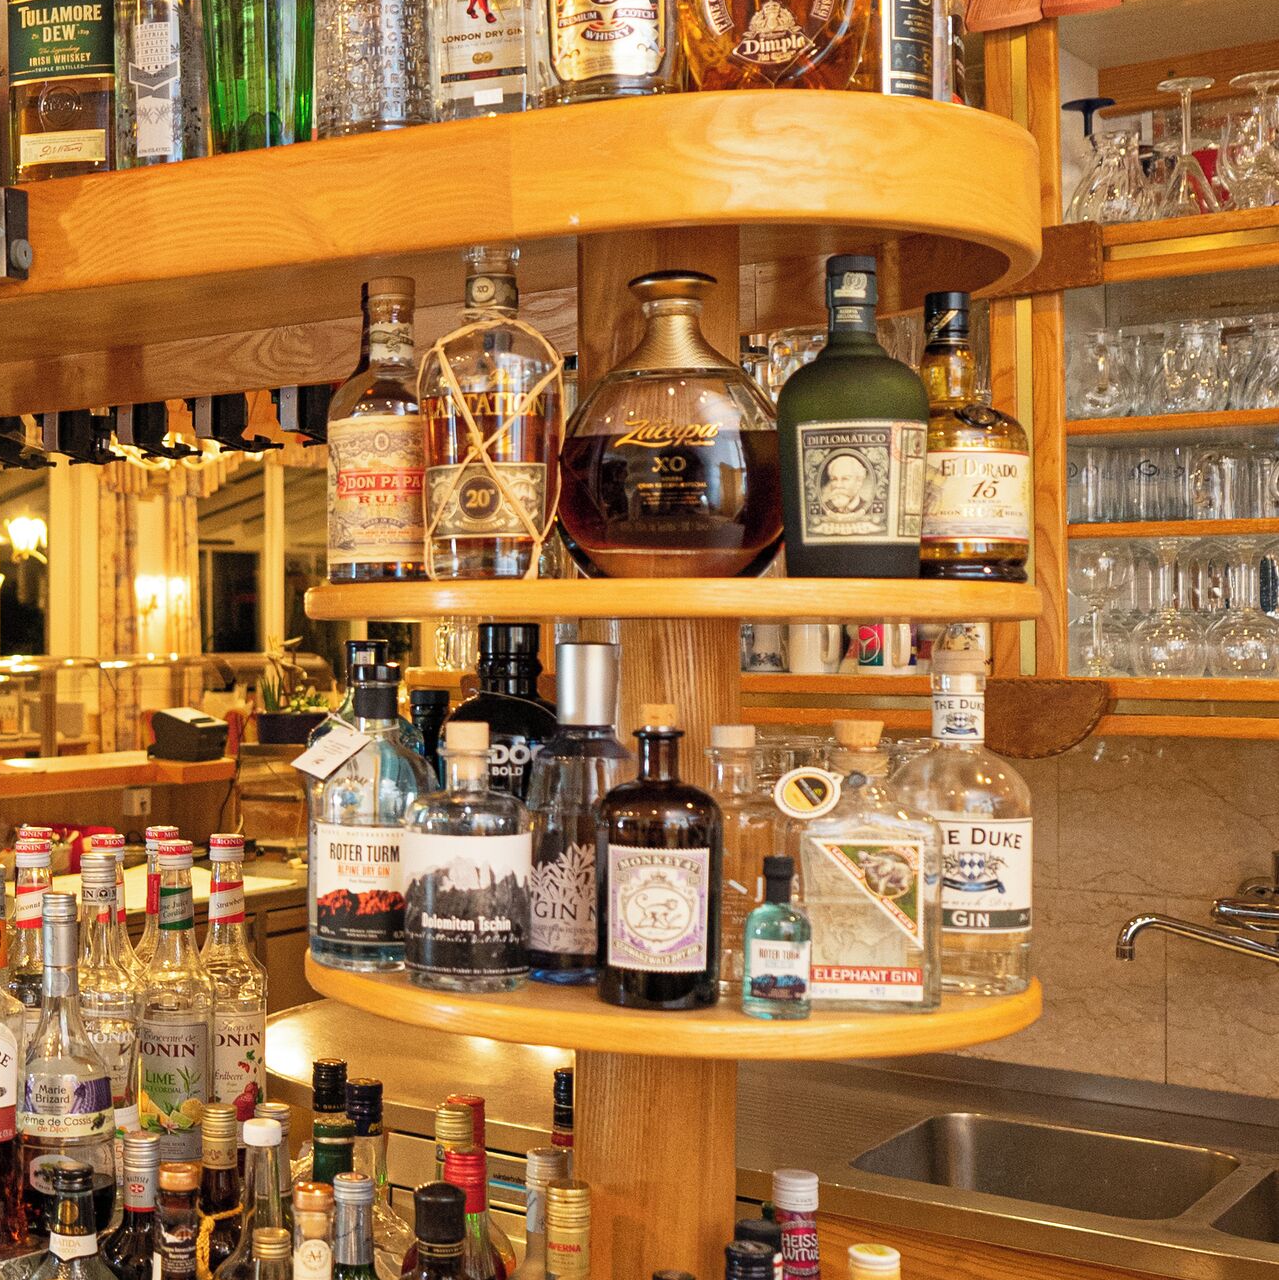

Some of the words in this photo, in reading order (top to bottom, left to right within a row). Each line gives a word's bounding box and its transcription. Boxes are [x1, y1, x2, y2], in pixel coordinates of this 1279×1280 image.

[17, 3, 103, 28] TULLAMORE
[557, 10, 598, 28] PREMIUM
[616, 8, 655, 20] SCOTCH
[42, 23, 76, 42] DEW
[441, 30, 482, 44] LONDON
[484, 28, 504, 40] DRY
[506, 26, 525, 37] GIN
[585, 26, 631, 40] WHISKY
[743, 34, 806, 56] Dimple
[29, 54, 51, 67] IRISH
[53, 52, 91, 64] WHISKEY
[614, 419, 720, 448] Zacapa
[651, 456, 687, 473] XO
[940, 459, 958, 477] EL
[961, 458, 1019, 478] DORADO
[348, 476, 376, 489] DON
[381, 475, 421, 489] PAPA
[970, 480, 998, 499] 15
[358, 495, 409, 504] RUM
[934, 700, 955, 710] THE
[492, 766, 524, 777] BOLD
[971, 827, 1023, 850] DUKE
[329, 842, 363, 863] ROTER
[366, 844, 401, 863] TURM
[377, 866, 391, 877] GIN
[618, 855, 681, 871] MONKEY
[535, 900, 577, 920] GIN
[421, 911, 475, 932] Dolomiten
[478, 915, 512, 931] Tschin
[951, 911, 991, 928] GIN
[813, 970, 891, 982] ELEPHANT
[891, 971, 918, 983] GIN
[145, 1069, 176, 1086] LIME
[39, 1084, 67, 1094] Marie
[35, 1093, 70, 1104] Brizard
[48, 1116, 61, 1127] de
[64, 1116, 92, 1127] Cassis
[50, 1125, 69, 1134] Dijon
[547, 1241, 582, 1253] AVERNA
